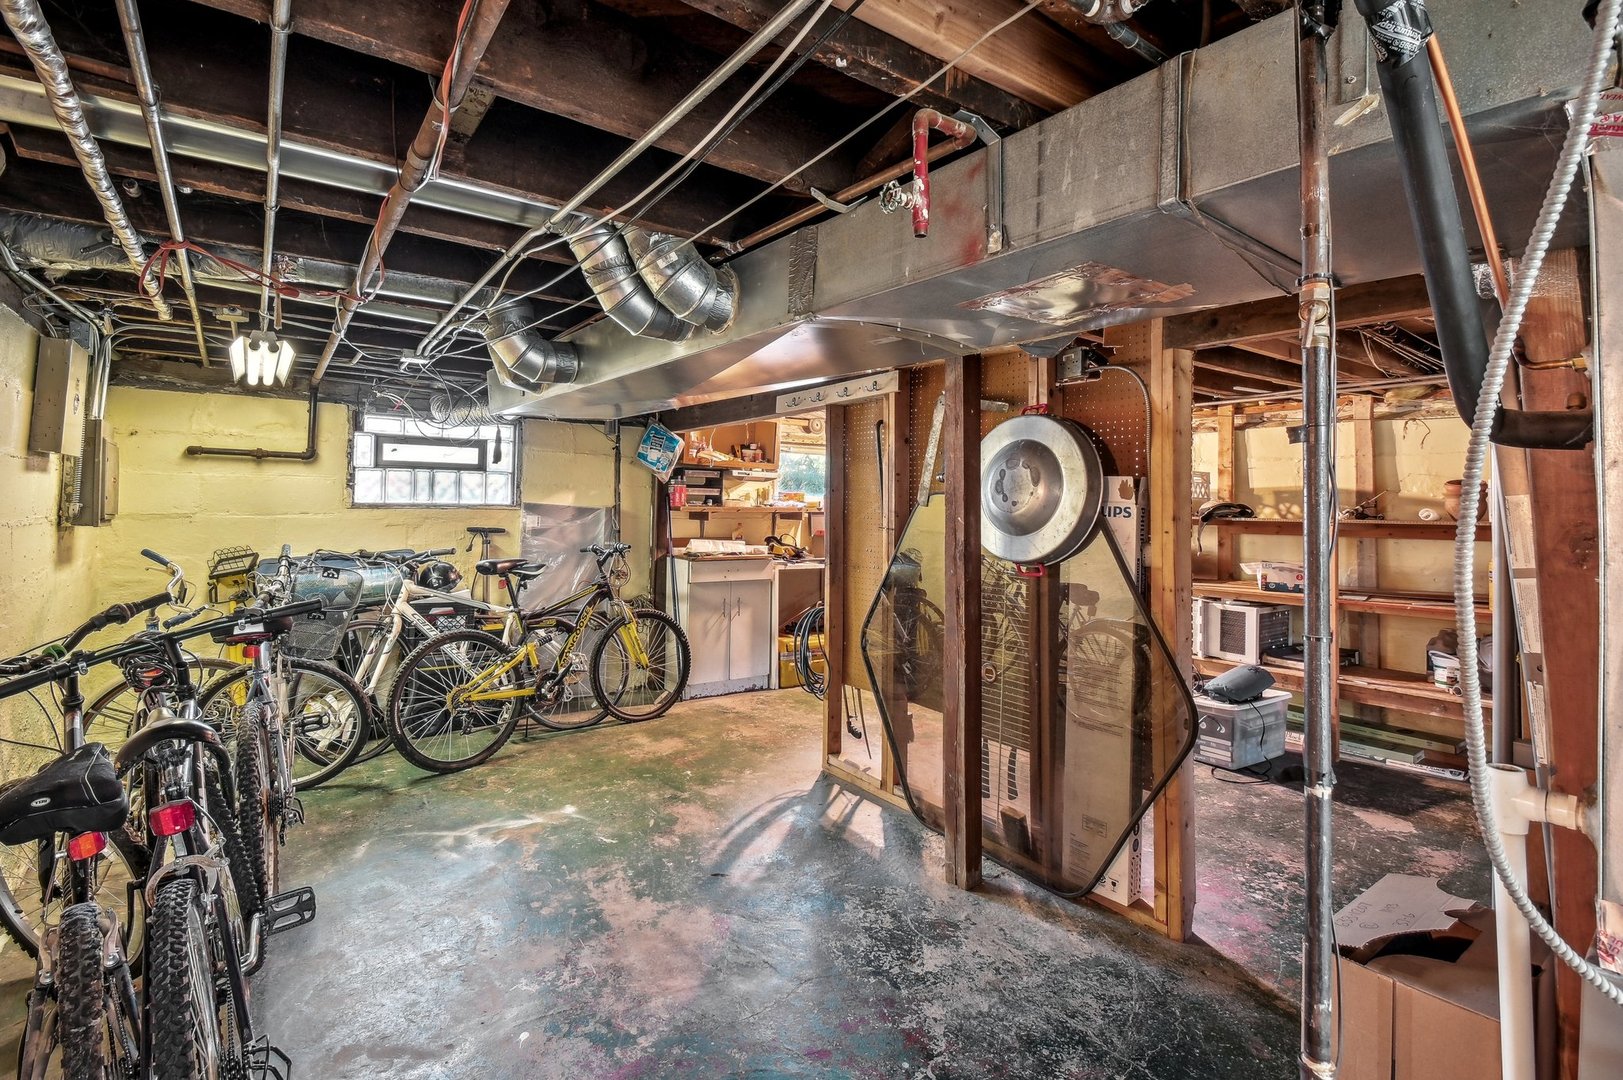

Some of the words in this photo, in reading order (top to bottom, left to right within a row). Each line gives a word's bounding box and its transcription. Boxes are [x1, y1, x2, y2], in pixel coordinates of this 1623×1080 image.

[1394, 26, 1421, 42] Venture
[1102, 505, 1132, 518] LIPS
[560, 606, 592, 668] MONGOOSE
